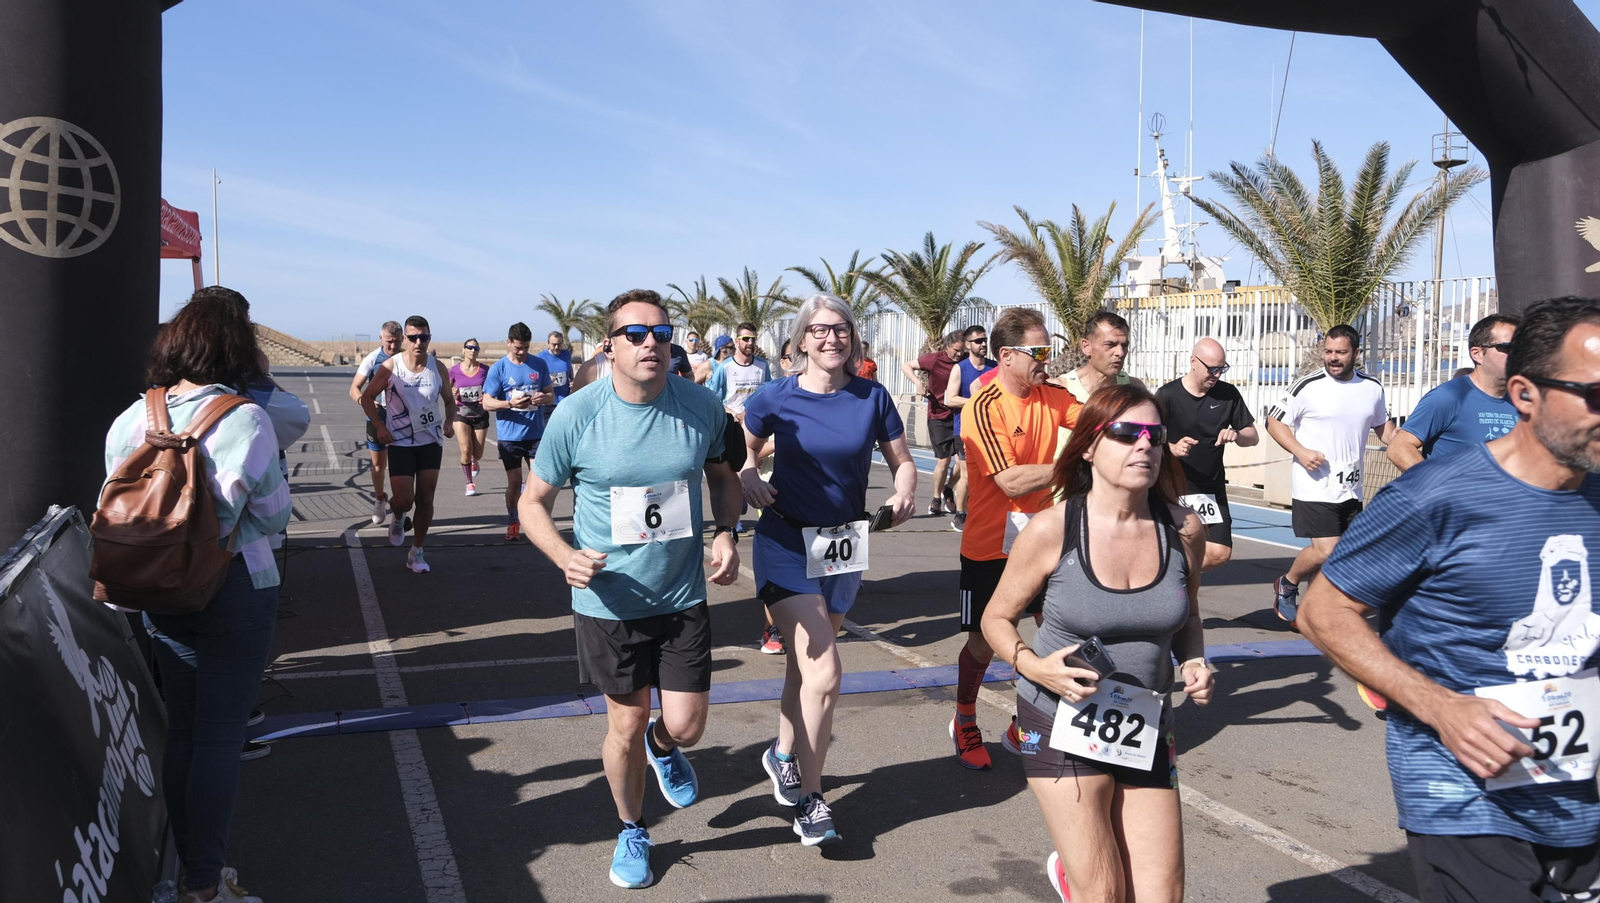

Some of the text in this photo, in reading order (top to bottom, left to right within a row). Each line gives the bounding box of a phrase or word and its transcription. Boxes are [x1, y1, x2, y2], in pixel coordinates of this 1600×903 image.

[463, 391, 479, 399] 444
[420, 411, 434, 425] 36
[1336, 470, 1360, 483] 145
[645, 504, 662, 529] 6
[824, 538, 853, 562] 40
[1070, 702, 1146, 749] 482
[1531, 710, 1589, 760] 52
